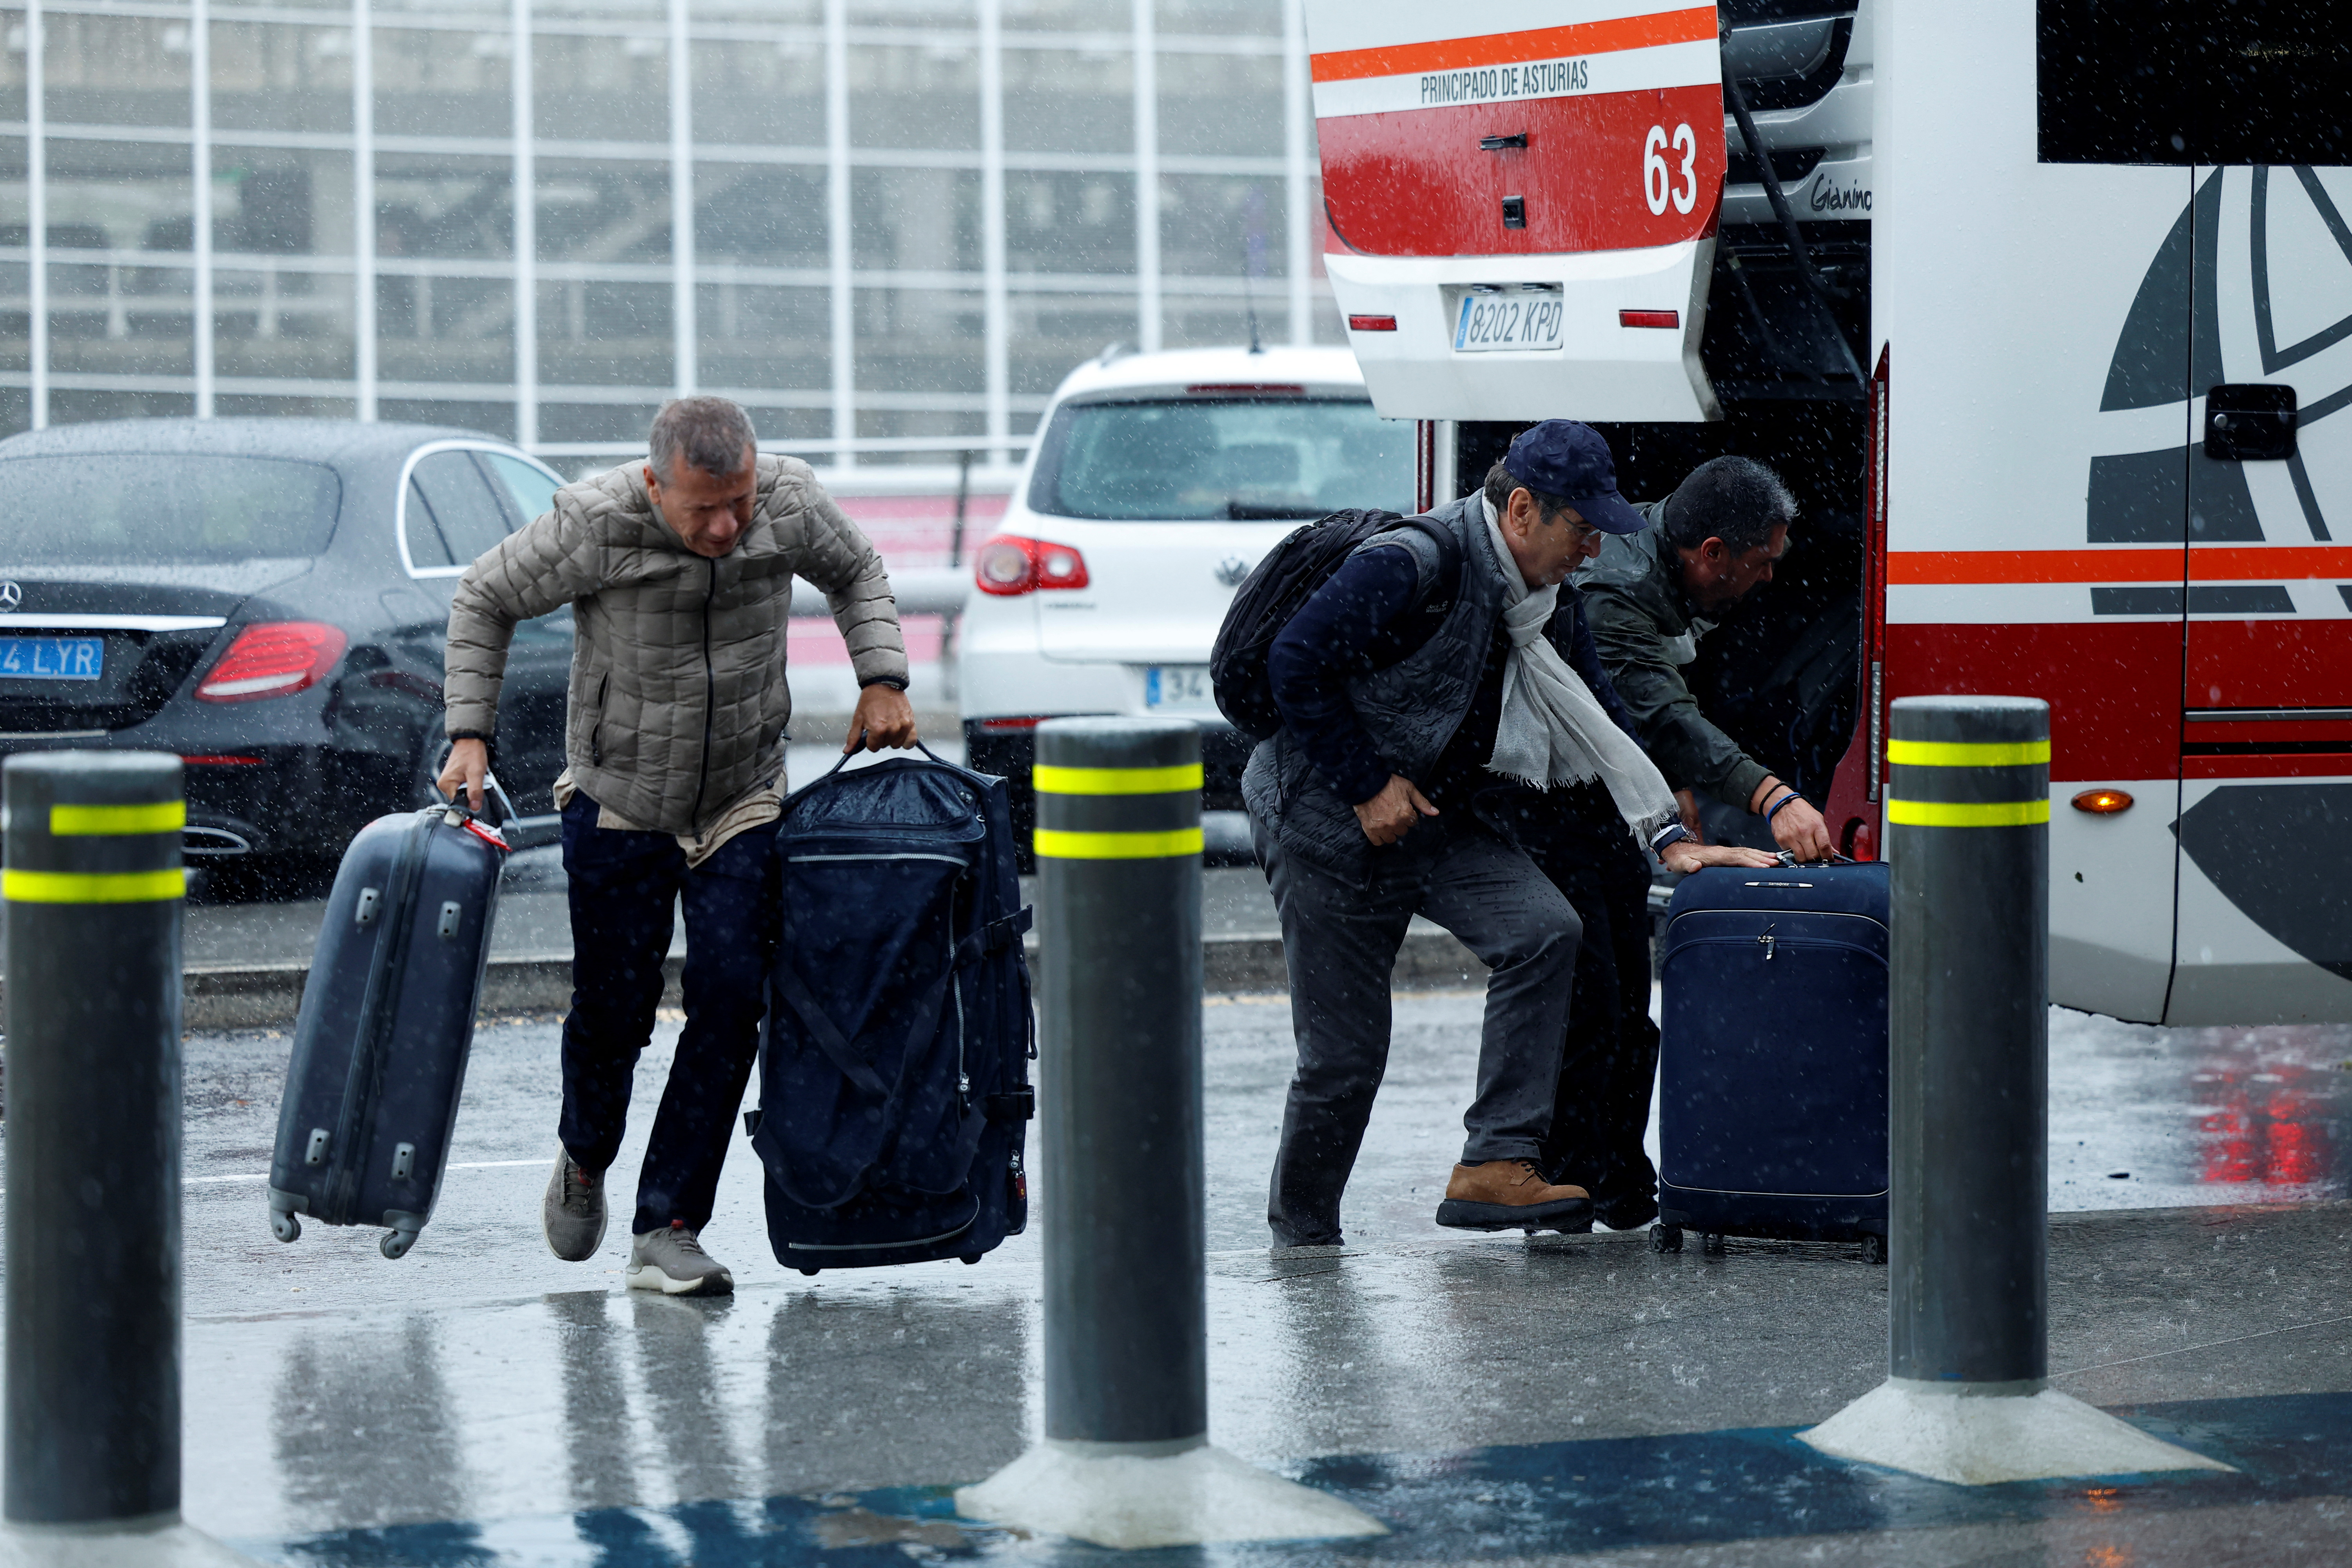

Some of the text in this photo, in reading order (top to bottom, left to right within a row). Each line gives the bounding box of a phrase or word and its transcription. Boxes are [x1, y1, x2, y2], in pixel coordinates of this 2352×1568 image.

[1422, 60, 1588, 104] PRINCIPADO DE ASTURIAS
[1643, 123, 1697, 216] 63
[1470, 301, 1563, 343] 8202 KPD
[0, 642, 94, 674] 4 LYR
